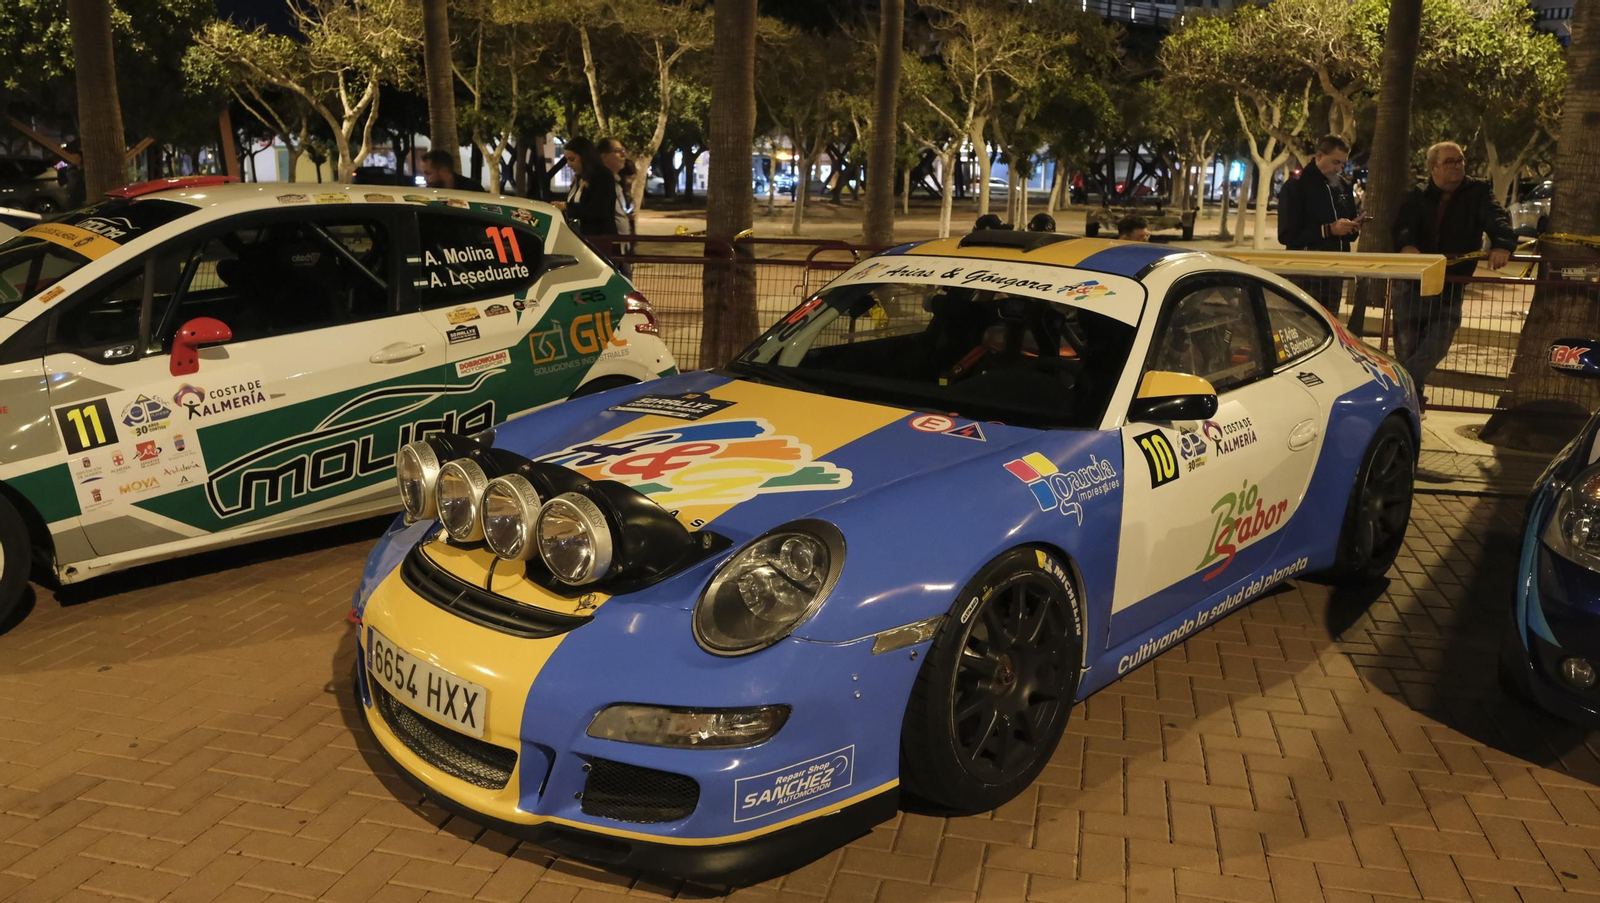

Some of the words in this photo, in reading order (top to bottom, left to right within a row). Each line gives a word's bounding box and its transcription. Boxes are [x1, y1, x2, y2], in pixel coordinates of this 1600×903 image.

[425, 250, 441, 266] A.
[445, 246, 495, 264] Molina
[485, 226, 523, 264] 11
[430, 272, 447, 289] A.
[450, 262, 529, 285] Leseduarte
[878, 265, 935, 279] Arias
[940, 267, 964, 279] &
[570, 311, 628, 354] GIL
[1285, 327, 1299, 342] Arias
[1290, 336, 1315, 355] Belmonte
[461, 359, 507, 375] MOTORSPORT
[534, 359, 580, 376] SOLUCIONES
[582, 349, 630, 365] INDUSTRIALES
[209, 384, 246, 400] COSTA
[247, 380, 262, 391] DE
[203, 391, 266, 417] ALMERÍA
[67, 405, 107, 448] 11
[135, 426, 148, 437] 30
[924, 417, 945, 430] E
[1223, 420, 1244, 435] COSTA
[1243, 417, 1252, 427] DE
[1224, 428, 1258, 454] ALMERÍA
[1141, 434, 1175, 482] 10
[1049, 454, 1117, 526] garcía
[1196, 479, 1258, 571] Bio
[1203, 498, 1288, 582] Sabor
[1054, 565, 1081, 636] MICHELIN
[1117, 621, 1194, 675] Cultivando
[1196, 608, 1209, 629] la
[1209, 593, 1244, 620] salud
[1244, 578, 1265, 600] del
[1264, 556, 1308, 593] planeta
[374, 640, 419, 700] 6654
[426, 672, 481, 729] HXX
[775, 769, 806, 785] Repair
[808, 761, 831, 776] Shop
[742, 767, 835, 809] SANCHEZ
[777, 782, 832, 806] AUTOMOCION
